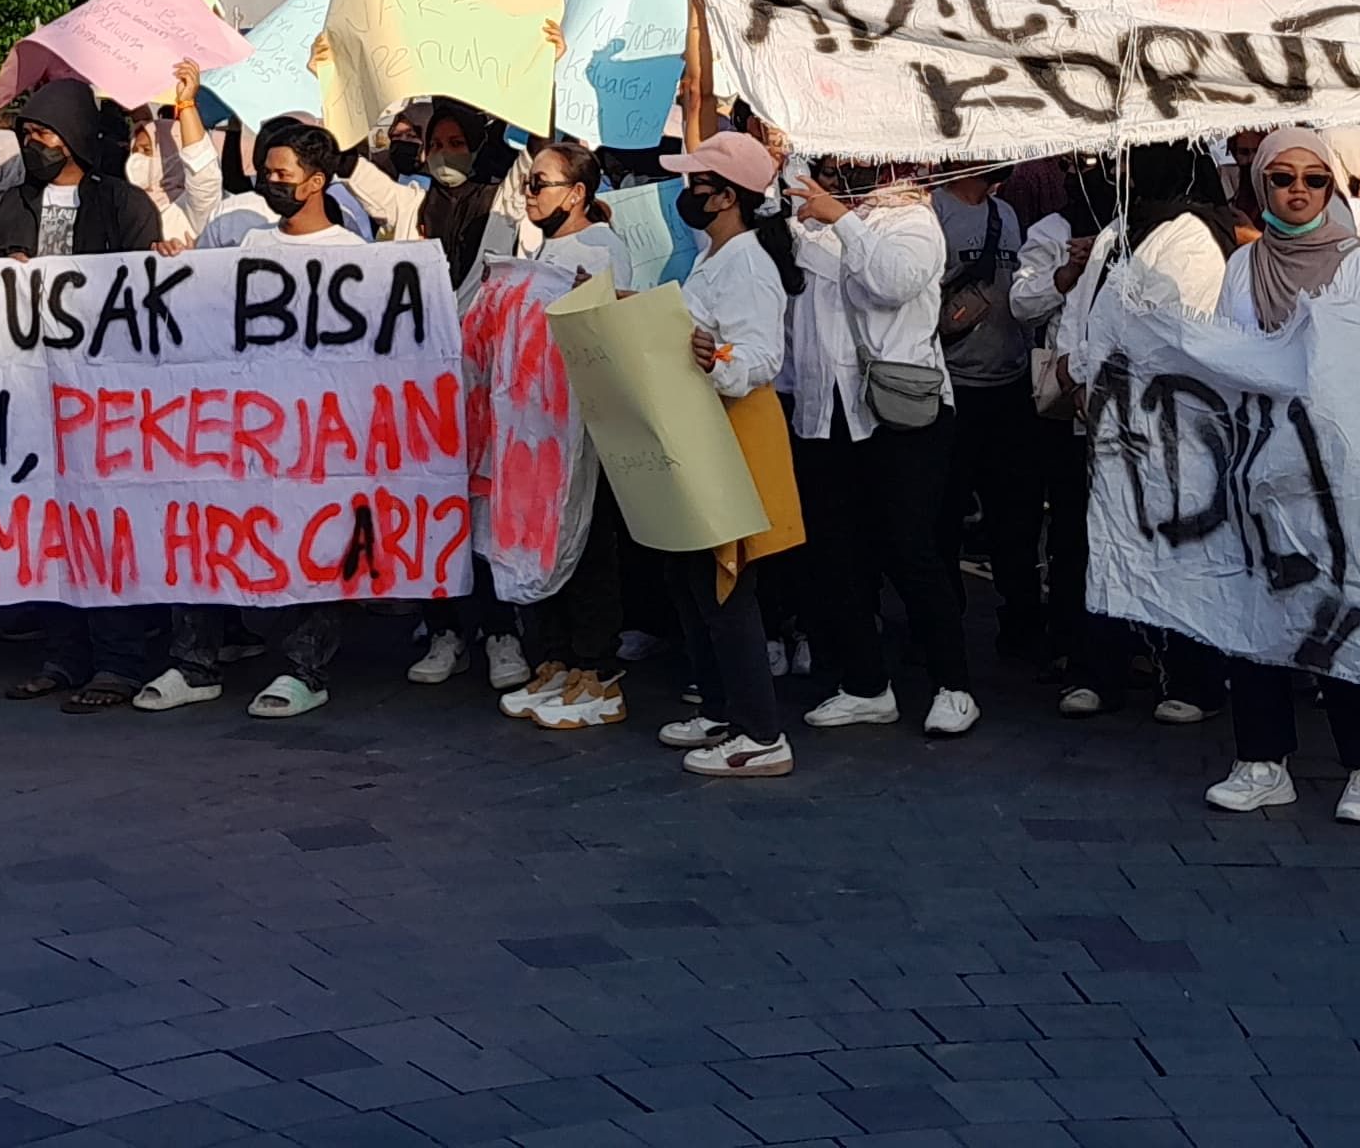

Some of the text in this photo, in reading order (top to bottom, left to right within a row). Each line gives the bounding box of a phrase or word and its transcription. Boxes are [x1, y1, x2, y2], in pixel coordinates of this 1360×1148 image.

[234, 257, 426, 354] BISA
[51, 371, 461, 484] PEKERJAAN
[164, 499, 290, 595] HRS
